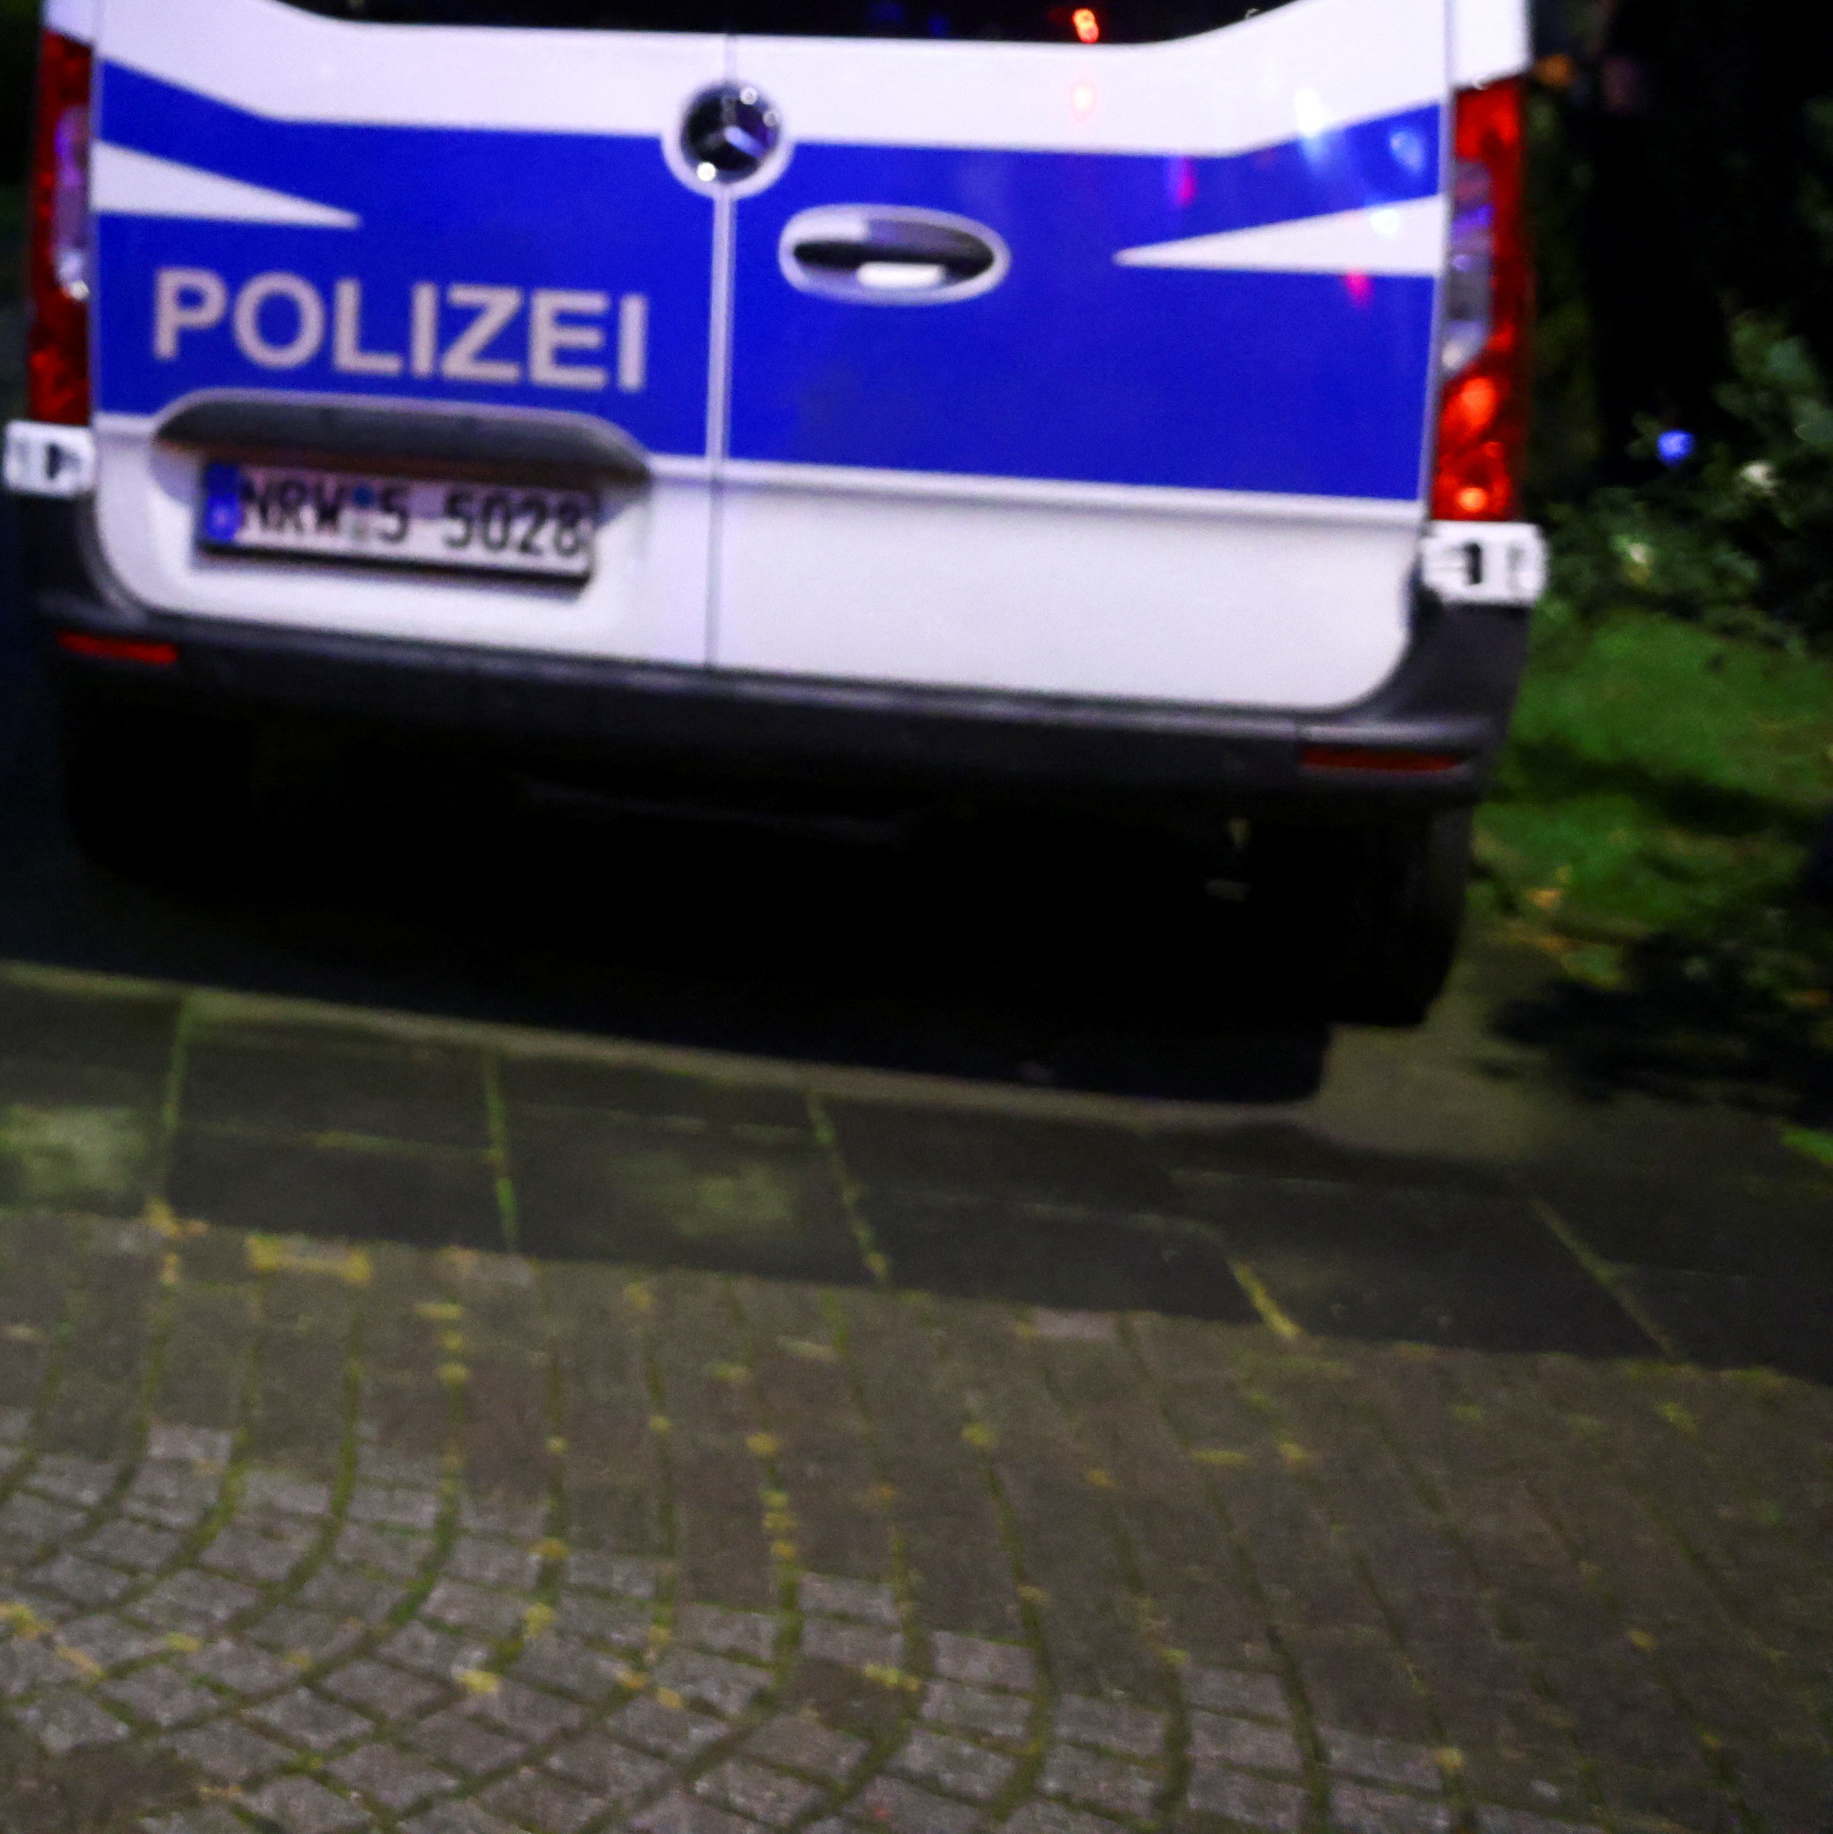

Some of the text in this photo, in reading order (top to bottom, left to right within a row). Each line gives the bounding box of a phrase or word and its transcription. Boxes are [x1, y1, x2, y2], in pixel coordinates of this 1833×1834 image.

[151, 264, 649, 394] POLIZEI
[376, 480, 411, 545] 5
[443, 488, 585, 559] 5028
